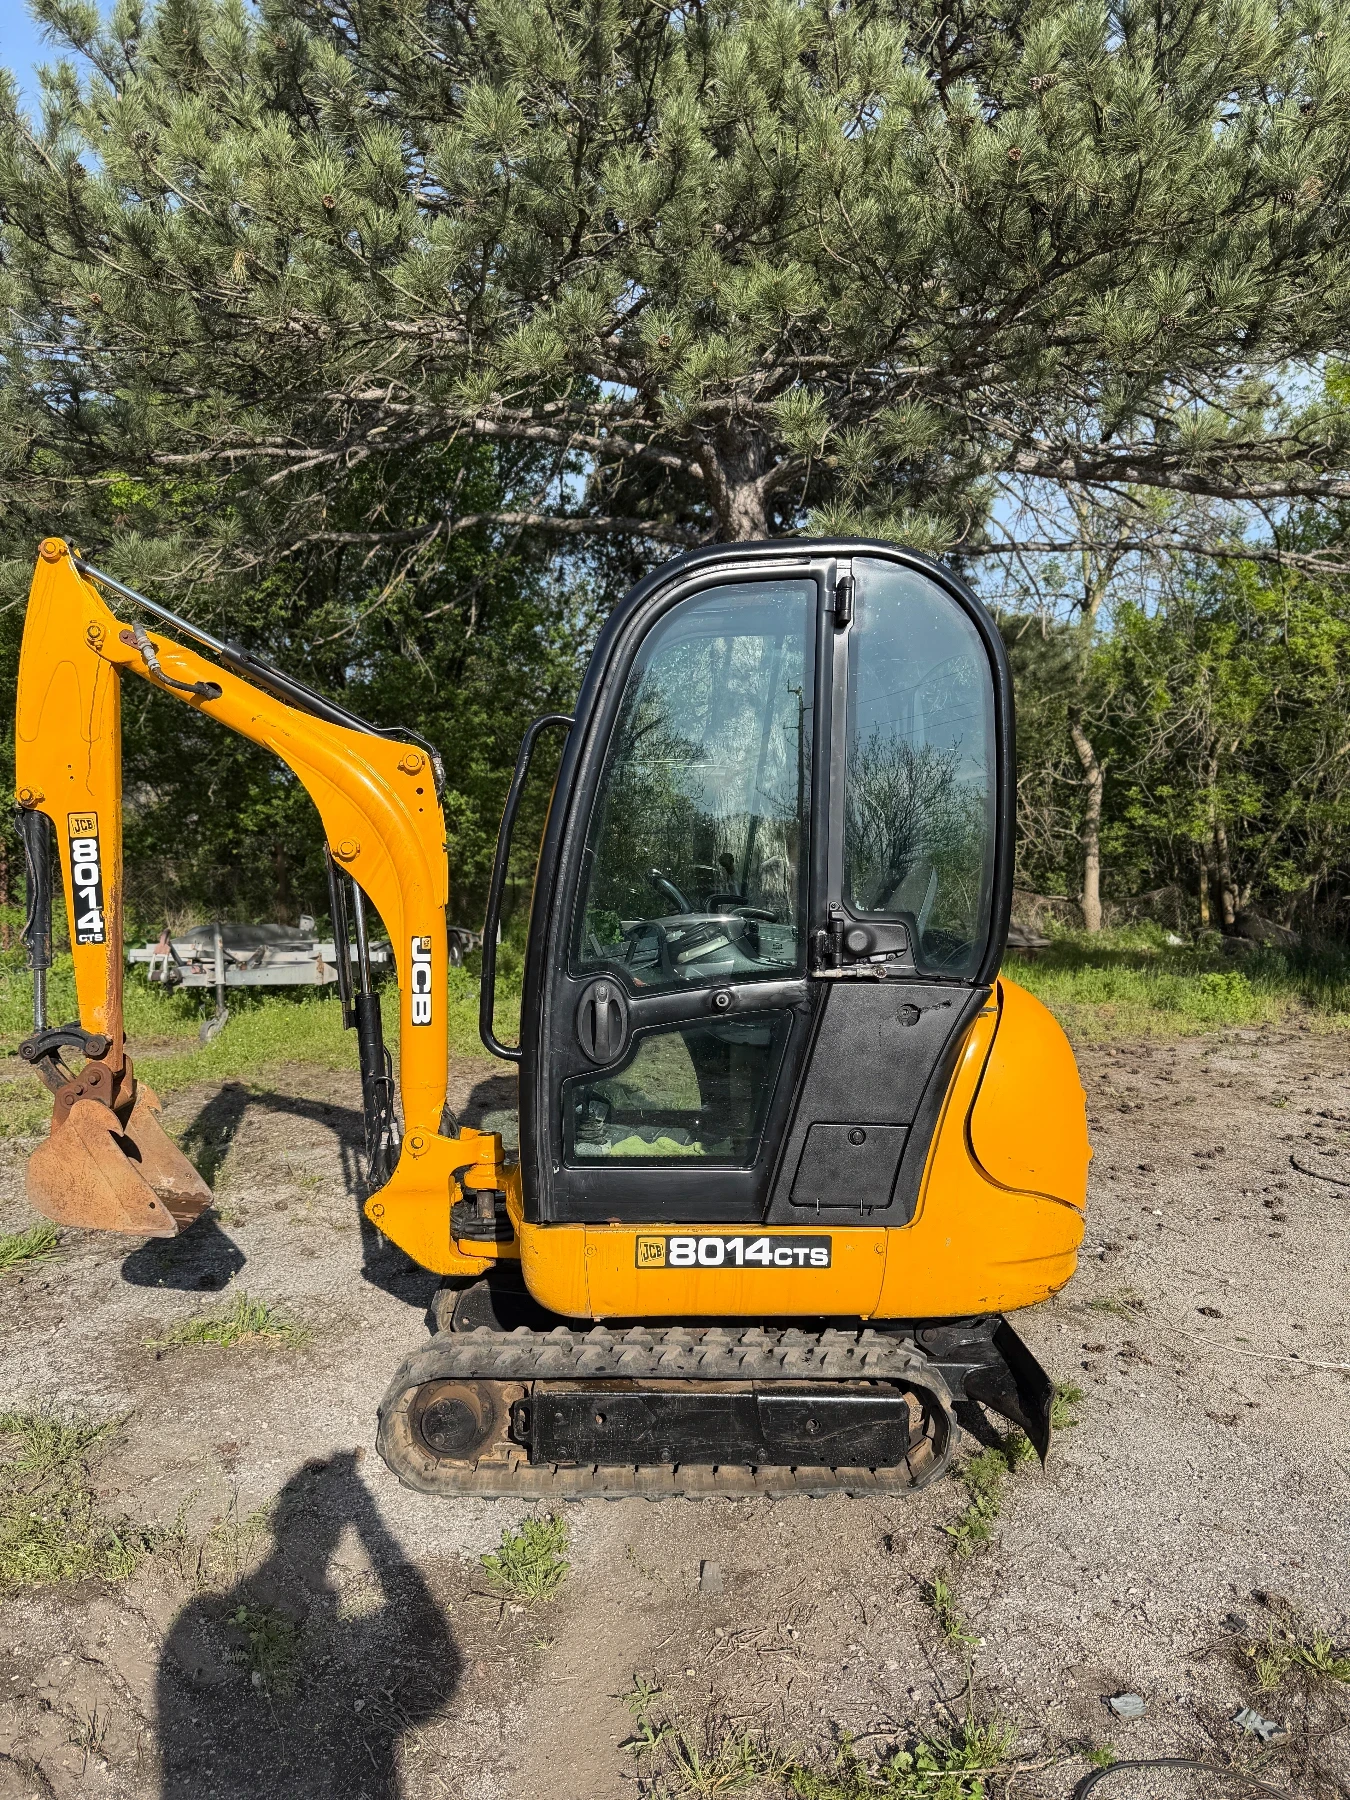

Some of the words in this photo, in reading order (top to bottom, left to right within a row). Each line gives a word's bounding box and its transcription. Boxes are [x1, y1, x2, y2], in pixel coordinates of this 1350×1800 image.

[74, 819, 94, 832] JCB
[73, 839, 103, 932] 8014
[78, 933, 103, 942] CTS
[412, 937, 431, 1024] JCB
[642, 1243, 662, 1260] JCB
